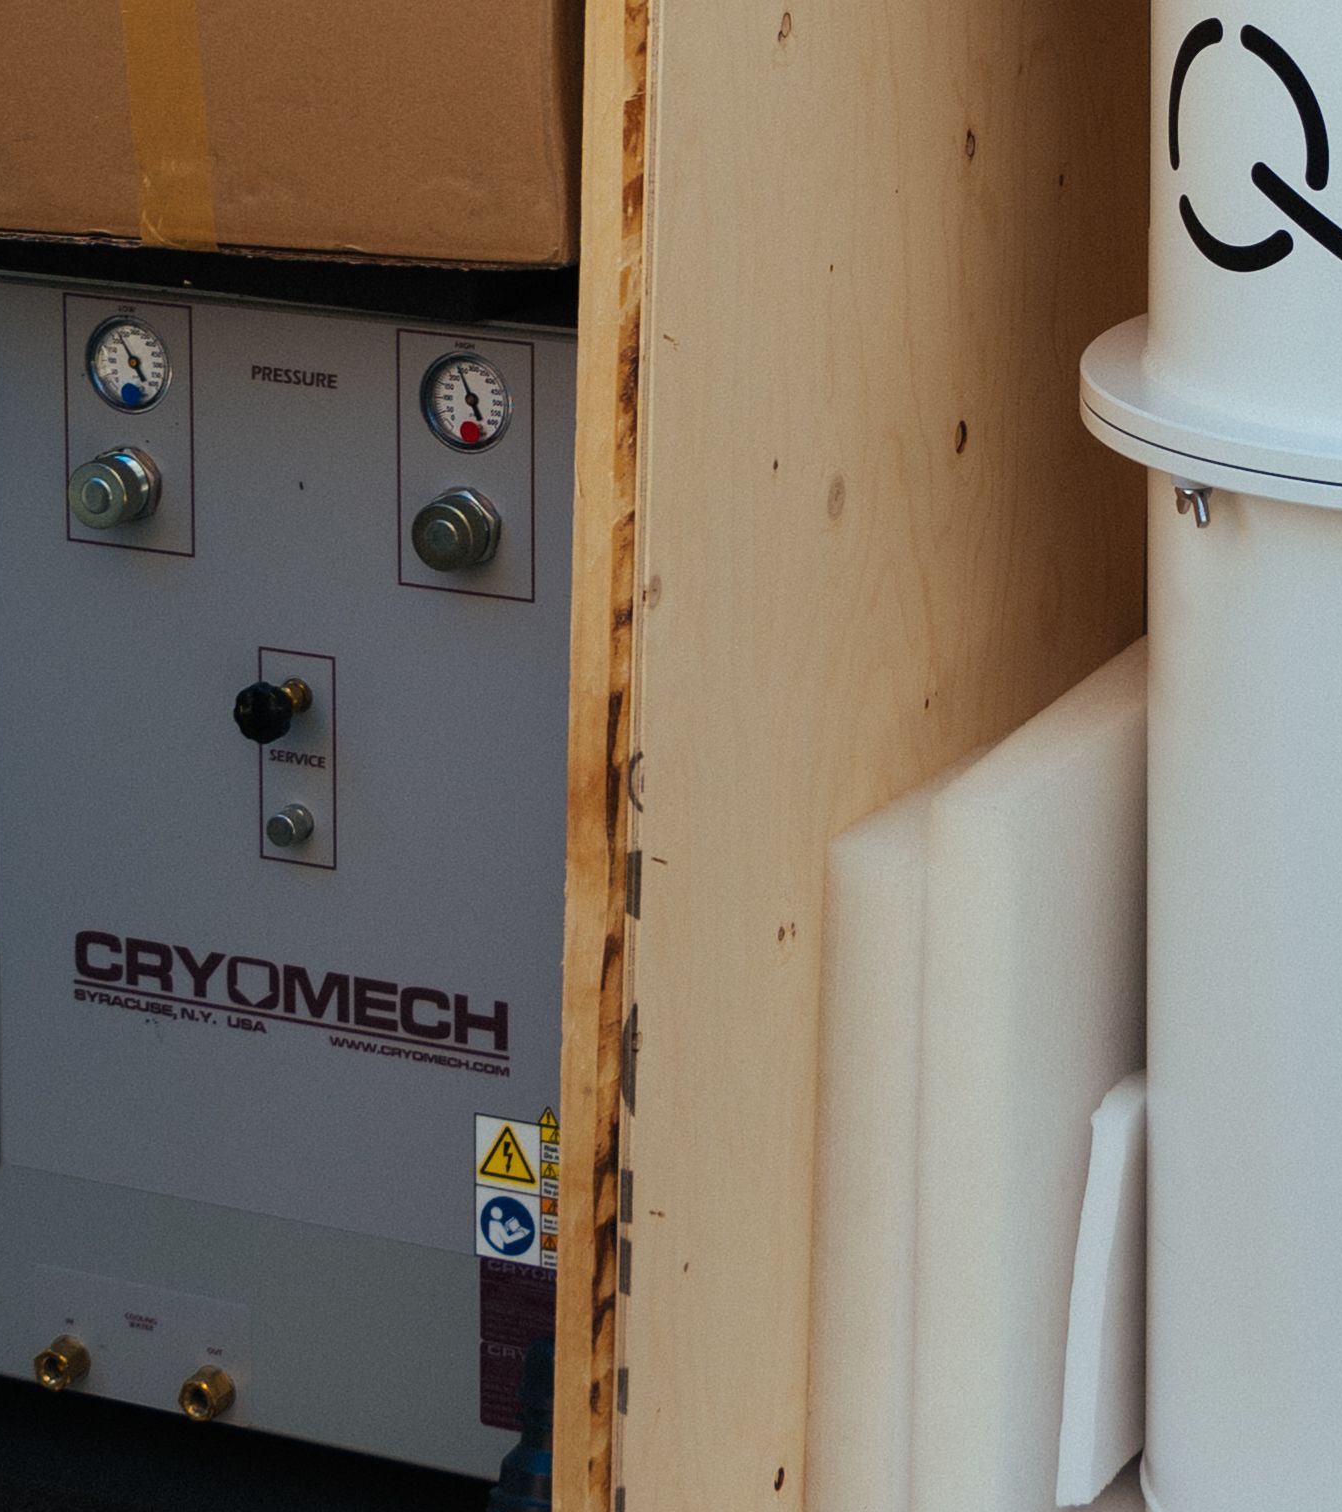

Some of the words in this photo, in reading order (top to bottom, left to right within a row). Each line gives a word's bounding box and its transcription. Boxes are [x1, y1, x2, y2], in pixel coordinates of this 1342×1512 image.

[454, 342, 475, 350] HIGH
[251, 365, 338, 389] PRESSURE
[269, 749, 326, 769] SERVICE
[75, 930, 508, 1051] CRYOMECH
[74, 988, 178, 1020] SYRACUSE,
[180, 1007, 217, 1025] N.Y.
[227, 1015, 267, 1034] USA
[329, 1035, 510, 1077] WWW.CRYOMECH.COM
